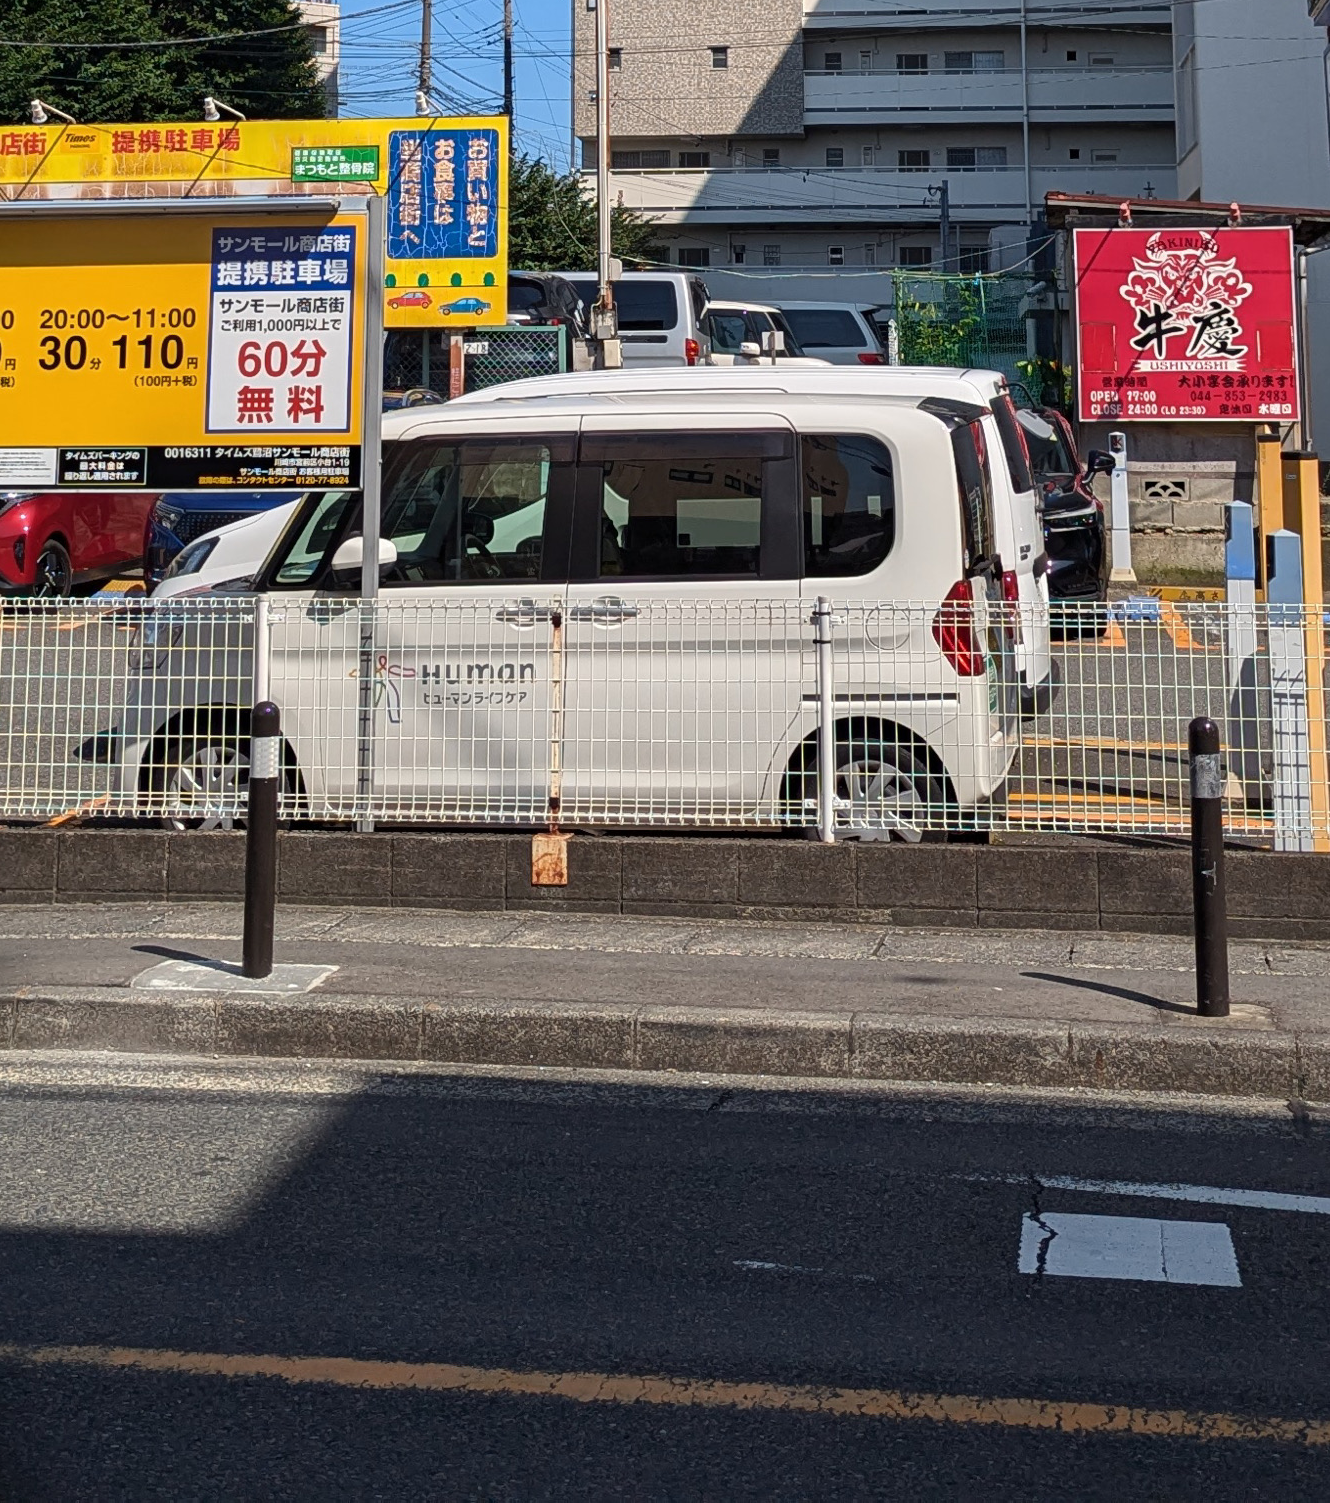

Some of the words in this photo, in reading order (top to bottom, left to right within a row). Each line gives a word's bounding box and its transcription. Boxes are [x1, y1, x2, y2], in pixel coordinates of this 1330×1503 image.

[65, 133, 97, 143] Times
[112, 128, 240, 154] 提携駐車場
[294, 162, 375, 176] まつもと整骨院
[433, 138, 455, 226] お食事は
[467, 138, 489, 247] お買い物と
[217, 235, 350, 253] サンモール商店街
[1146, 237, 1220, 254] YAKINIKU
[217, 259, 348, 285] 提携駐車場
[219, 297, 345, 314] サンモール商店街
[220, 318, 342, 333] ご利用1,000円以上で
[1131, 299, 1247, 359] 牛慶
[238, 339, 327, 378] 60分
[1150, 361, 1229, 371] USHIYOSHI
[1090, 391, 1119, 402] OPEN
[1091, 404, 1123, 415] CLOSE
[1128, 403, 1158, 415] 24:00
[1258, 403, 1293, 414] 水曜日
[65, 451, 140, 460] タイムズパーキングの
[165, 448, 212, 458] 0016311
[79, 461, 125, 470] 最大料金は
[422, 662, 537, 685] Human
[423, 691, 528, 705] ヒューマンライフケア
